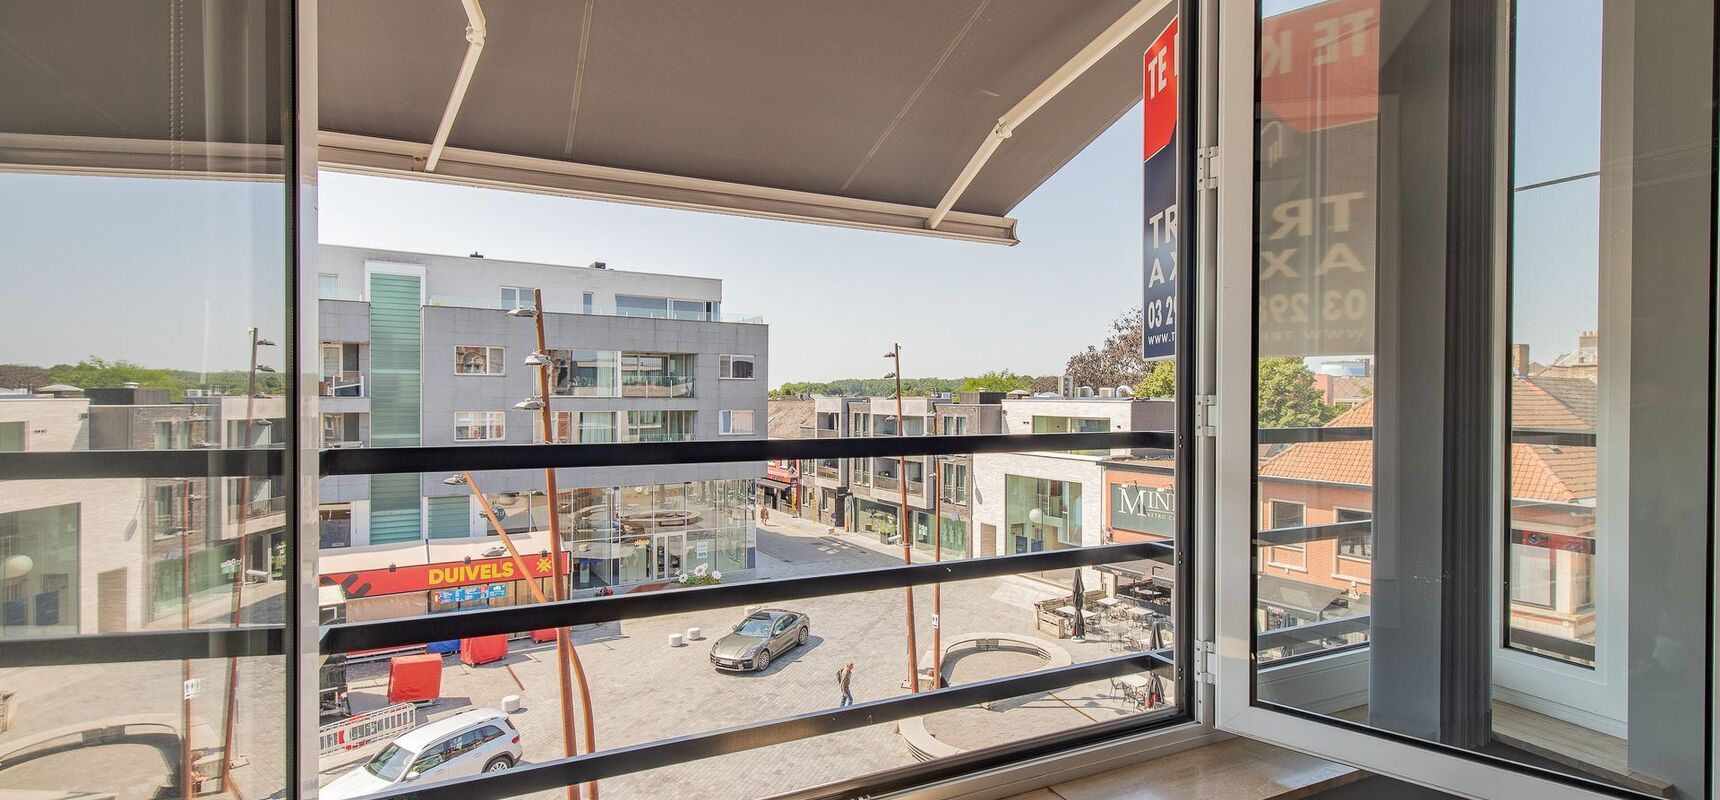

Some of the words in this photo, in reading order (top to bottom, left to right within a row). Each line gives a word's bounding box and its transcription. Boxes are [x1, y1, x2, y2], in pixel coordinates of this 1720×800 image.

[1148, 45, 1167, 100] TE
[1148, 300, 1162, 329] 03
[428, 561, 514, 585] DUIVELS
